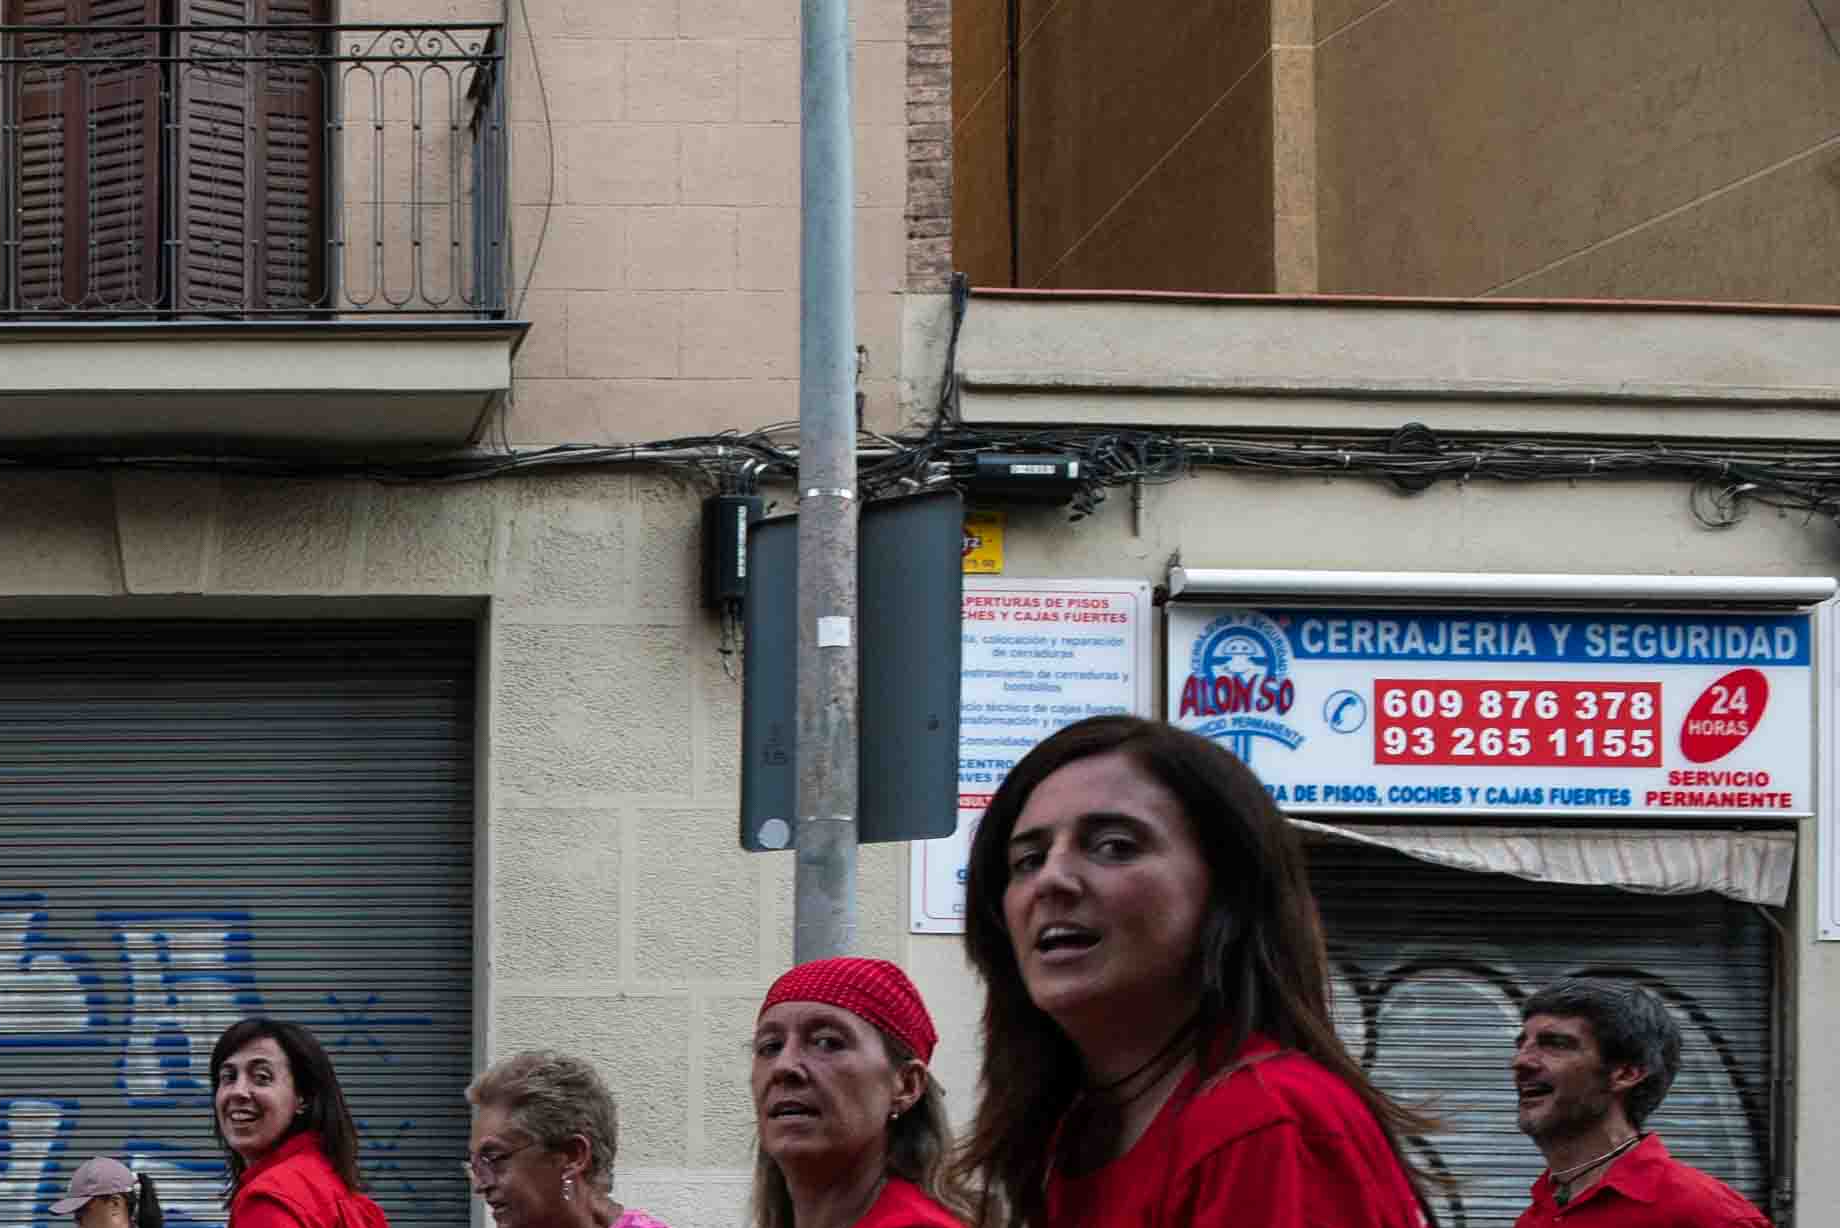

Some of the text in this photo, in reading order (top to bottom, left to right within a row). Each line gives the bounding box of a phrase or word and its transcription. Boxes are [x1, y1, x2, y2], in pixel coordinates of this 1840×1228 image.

[1045, 598, 1064, 609] DE
[1067, 598, 1109, 610] PISOS
[1000, 611, 1009, 621] Y
[1015, 611, 1059, 622] CAJAS
[1064, 612, 1128, 623] FUERTES
[1303, 619, 1799, 660] CERRAJERIA Y SEGURIDAD
[992, 648, 1074, 659] de cerraduras
[1179, 673, 1295, 720] ALONSO
[1383, 689, 1655, 721] 609 876 378
[1709, 685, 1750, 716] 24
[1687, 719, 1750, 737] HORAS
[1383, 726, 1655, 758] 93 265 1155
[1667, 770, 1770, 788] SERVICIO
[1295, 785, 1318, 801] DE
[1323, 785, 1382, 804] PISOS,
[1388, 785, 1460, 803] COCHES
[1468, 786, 1480, 803] Y
[1486, 787, 1545, 805] CAJAS
[1550, 787, 1632, 806] FUERTES
[1645, 790, 1793, 808] PERMANENTE
